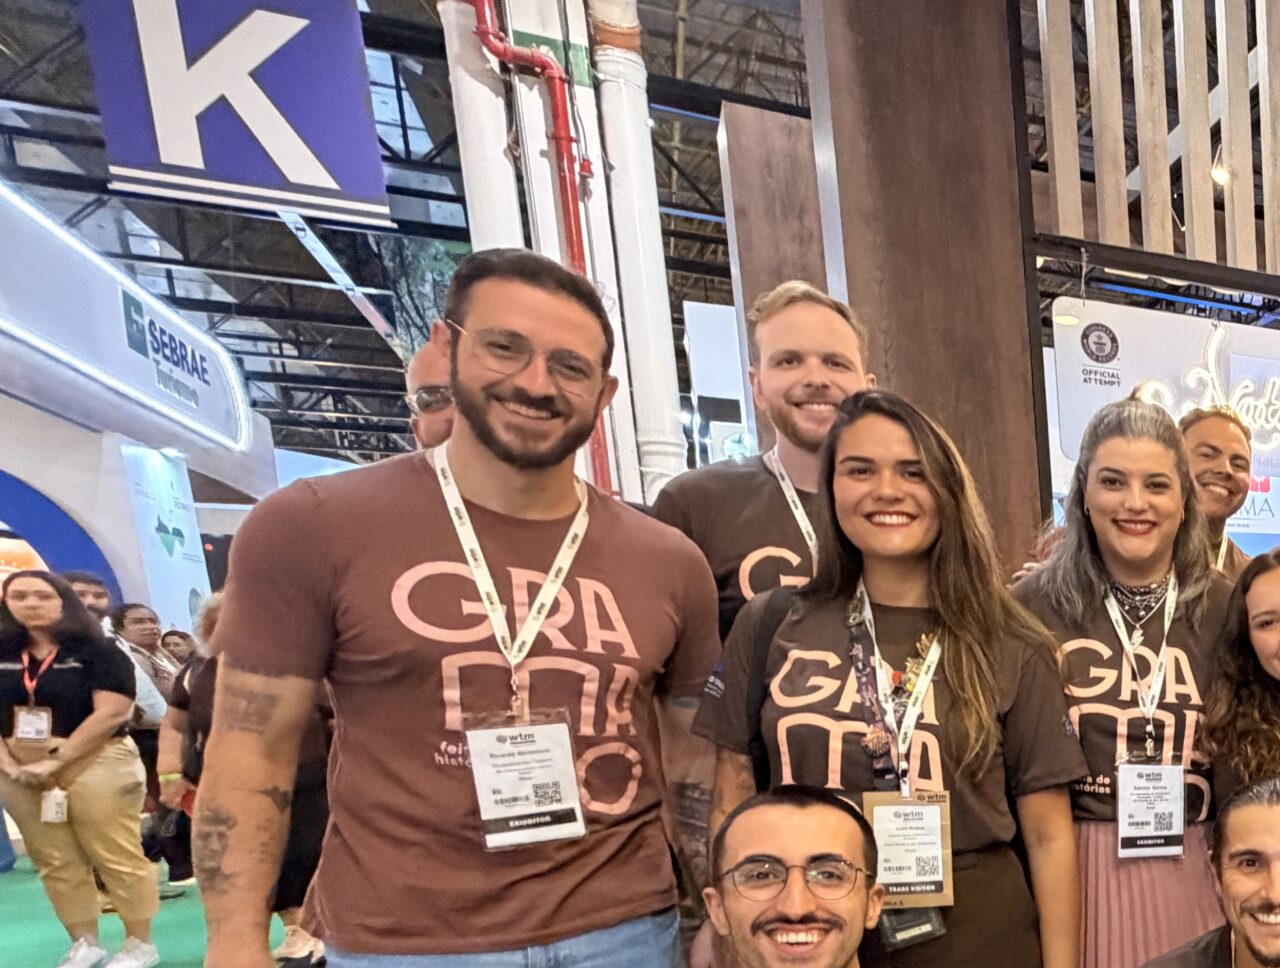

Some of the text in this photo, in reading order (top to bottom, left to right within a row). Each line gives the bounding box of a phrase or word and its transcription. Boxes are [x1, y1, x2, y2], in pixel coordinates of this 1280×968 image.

[133, 0, 341, 190] K
[148, 318, 211, 386] SEBRAE
[1082, 368, 1121, 380] OFFICIAL
[1083, 377, 1121, 387] ATTEMPT
[391, 561, 641, 659] GRA
[441, 651, 640, 737] MA
[509, 732, 535, 741] wtm
[927, 793, 947, 801] wtm
[902, 810, 923, 818] wtm
[509, 815, 552, 828] EXHIBITOR
[911, 884, 936, 892] VISITOR
